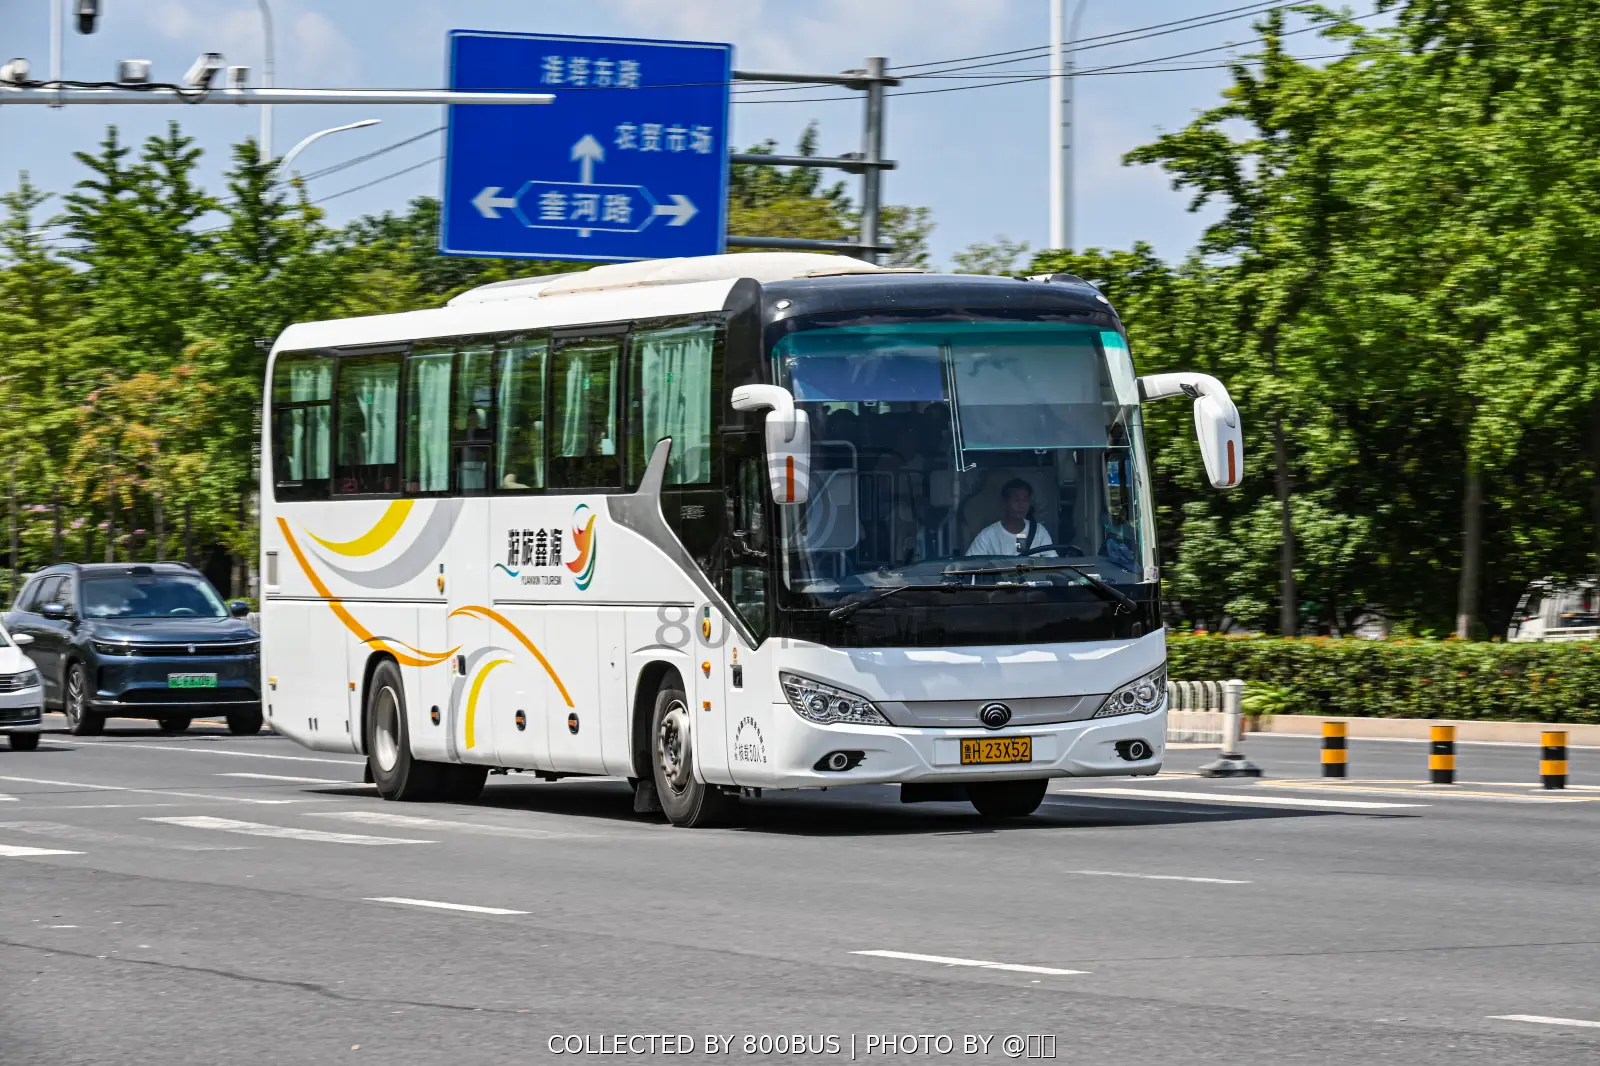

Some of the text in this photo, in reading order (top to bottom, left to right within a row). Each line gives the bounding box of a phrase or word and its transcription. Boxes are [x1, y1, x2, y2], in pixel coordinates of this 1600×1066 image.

[613, 121, 715, 154] 农贸市场
[538, 190, 633, 224] 奎河路
[541, 575, 562, 585] TOURISM
